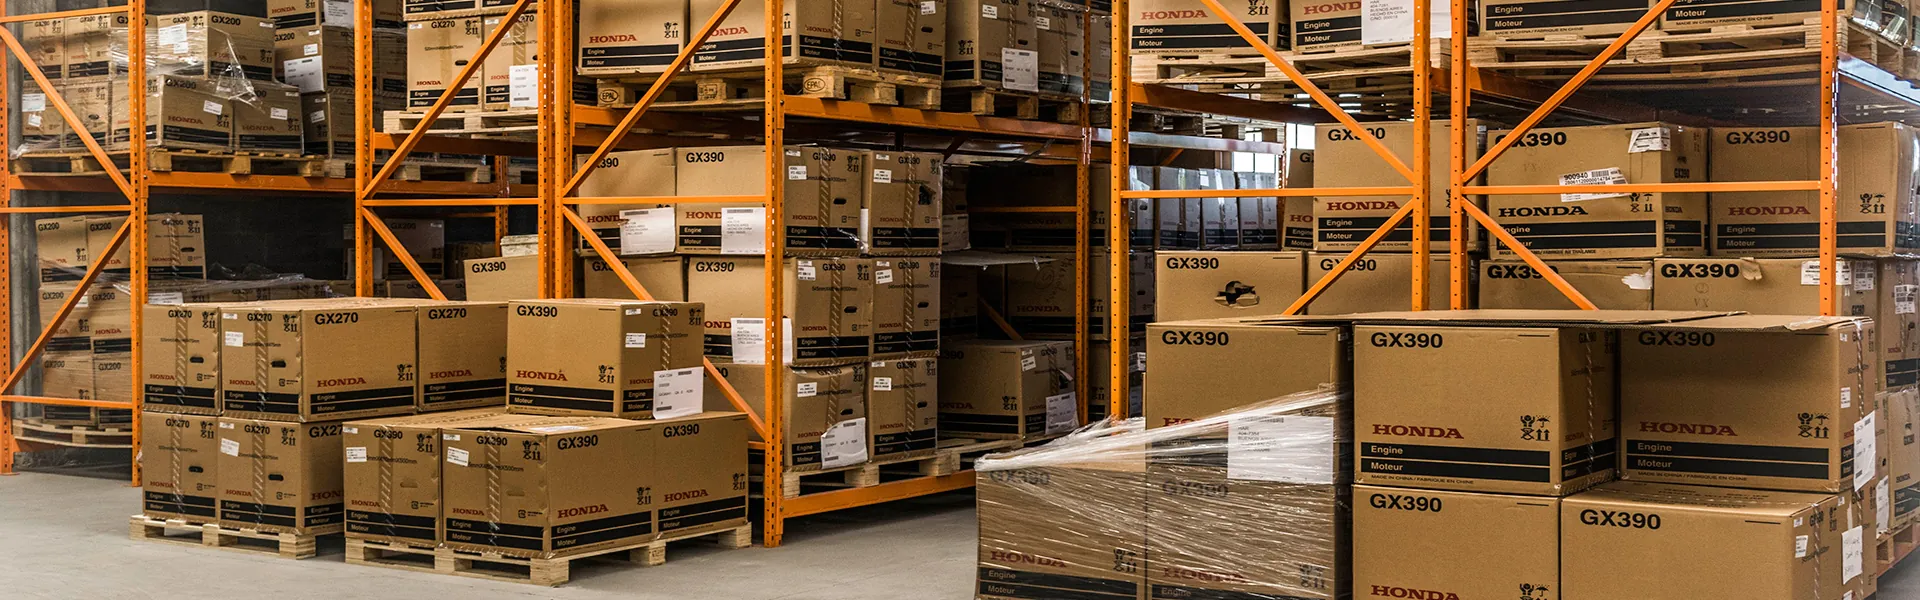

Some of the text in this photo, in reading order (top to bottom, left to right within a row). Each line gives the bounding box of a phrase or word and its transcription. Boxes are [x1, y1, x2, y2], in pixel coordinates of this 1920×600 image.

[271, 6, 296, 14] HONDA
[1304, 2, 1362, 15] HOND
[1495, 5, 1523, 13] Engine
[1140, 10, 1208, 20] HONDA
[1676, 10, 1706, 18] Moteur
[211, 15, 241, 25] GX200
[431, 20, 455, 28] GX270
[1304, 22, 1330, 30] Engine
[710, 27, 748, 36] ONDA
[589, 34, 637, 43] HONDA
[804, 37, 821, 45] Engine
[699, 54, 716, 62] Moteur
[165, 78, 197, 89] GX200
[168, 115, 204, 125] HONDA
[1727, 130, 1790, 144] GX390
[686, 152, 724, 162] GX390
[1327, 201, 1400, 211] HONDA
[1728, 206, 1811, 216] HONDA
[1498, 206, 1588, 217] HONDA
[587, 214, 620, 223] HOND
[1327, 219, 1352, 227] Engine
[38, 222, 59, 232] GX200
[90, 222, 112, 232] GX200
[472, 262, 506, 273] GX390
[696, 261, 734, 272] GX390
[1166, 257, 1219, 269] GX390
[1487, 265, 1559, 279] GX39
[1660, 263, 1739, 278] GX390
[169, 309, 192, 318] GX270
[428, 308, 467, 320] GX270
[517, 305, 558, 317] GX390
[247, 313, 272, 322] GX270
[315, 312, 358, 325] GX270
[1162, 330, 1229, 345] GX390
[1371, 332, 1443, 349] GX390
[1638, 330, 1715, 346] GX390
[99, 362, 121, 371] GX200
[429, 369, 473, 379] HONDA
[516, 370, 568, 381] HONDA
[317, 377, 367, 388] HONDA
[166, 419, 190, 428] GX270
[1639, 421, 1738, 436] HONDA
[244, 425, 270, 434] GX270
[309, 424, 343, 438] GX27
[663, 424, 700, 437] GX390
[1372, 424, 1464, 439] HONDA
[373, 430, 403, 440] GX390
[476, 436, 507, 445] GX390
[558, 435, 598, 450] GX390
[1371, 446, 1403, 455] Engine
[1637, 443, 1672, 452] Engine
[1371, 462, 1404, 471] Moteur
[1637, 459, 1672, 468] Moteur
[312, 491, 342, 500] HON
[664, 489, 709, 502] HONDA
[1370, 493, 1442, 512] GX390
[452, 508, 485, 516] HONDA
[557, 504, 609, 518] HONDA
[1580, 509, 1661, 529] GX390
[557, 525, 576, 533] Engine
[452, 533, 472, 541] Moteur
[988, 571, 1016, 579] Engine
[988, 585, 1015, 594] Moteur
